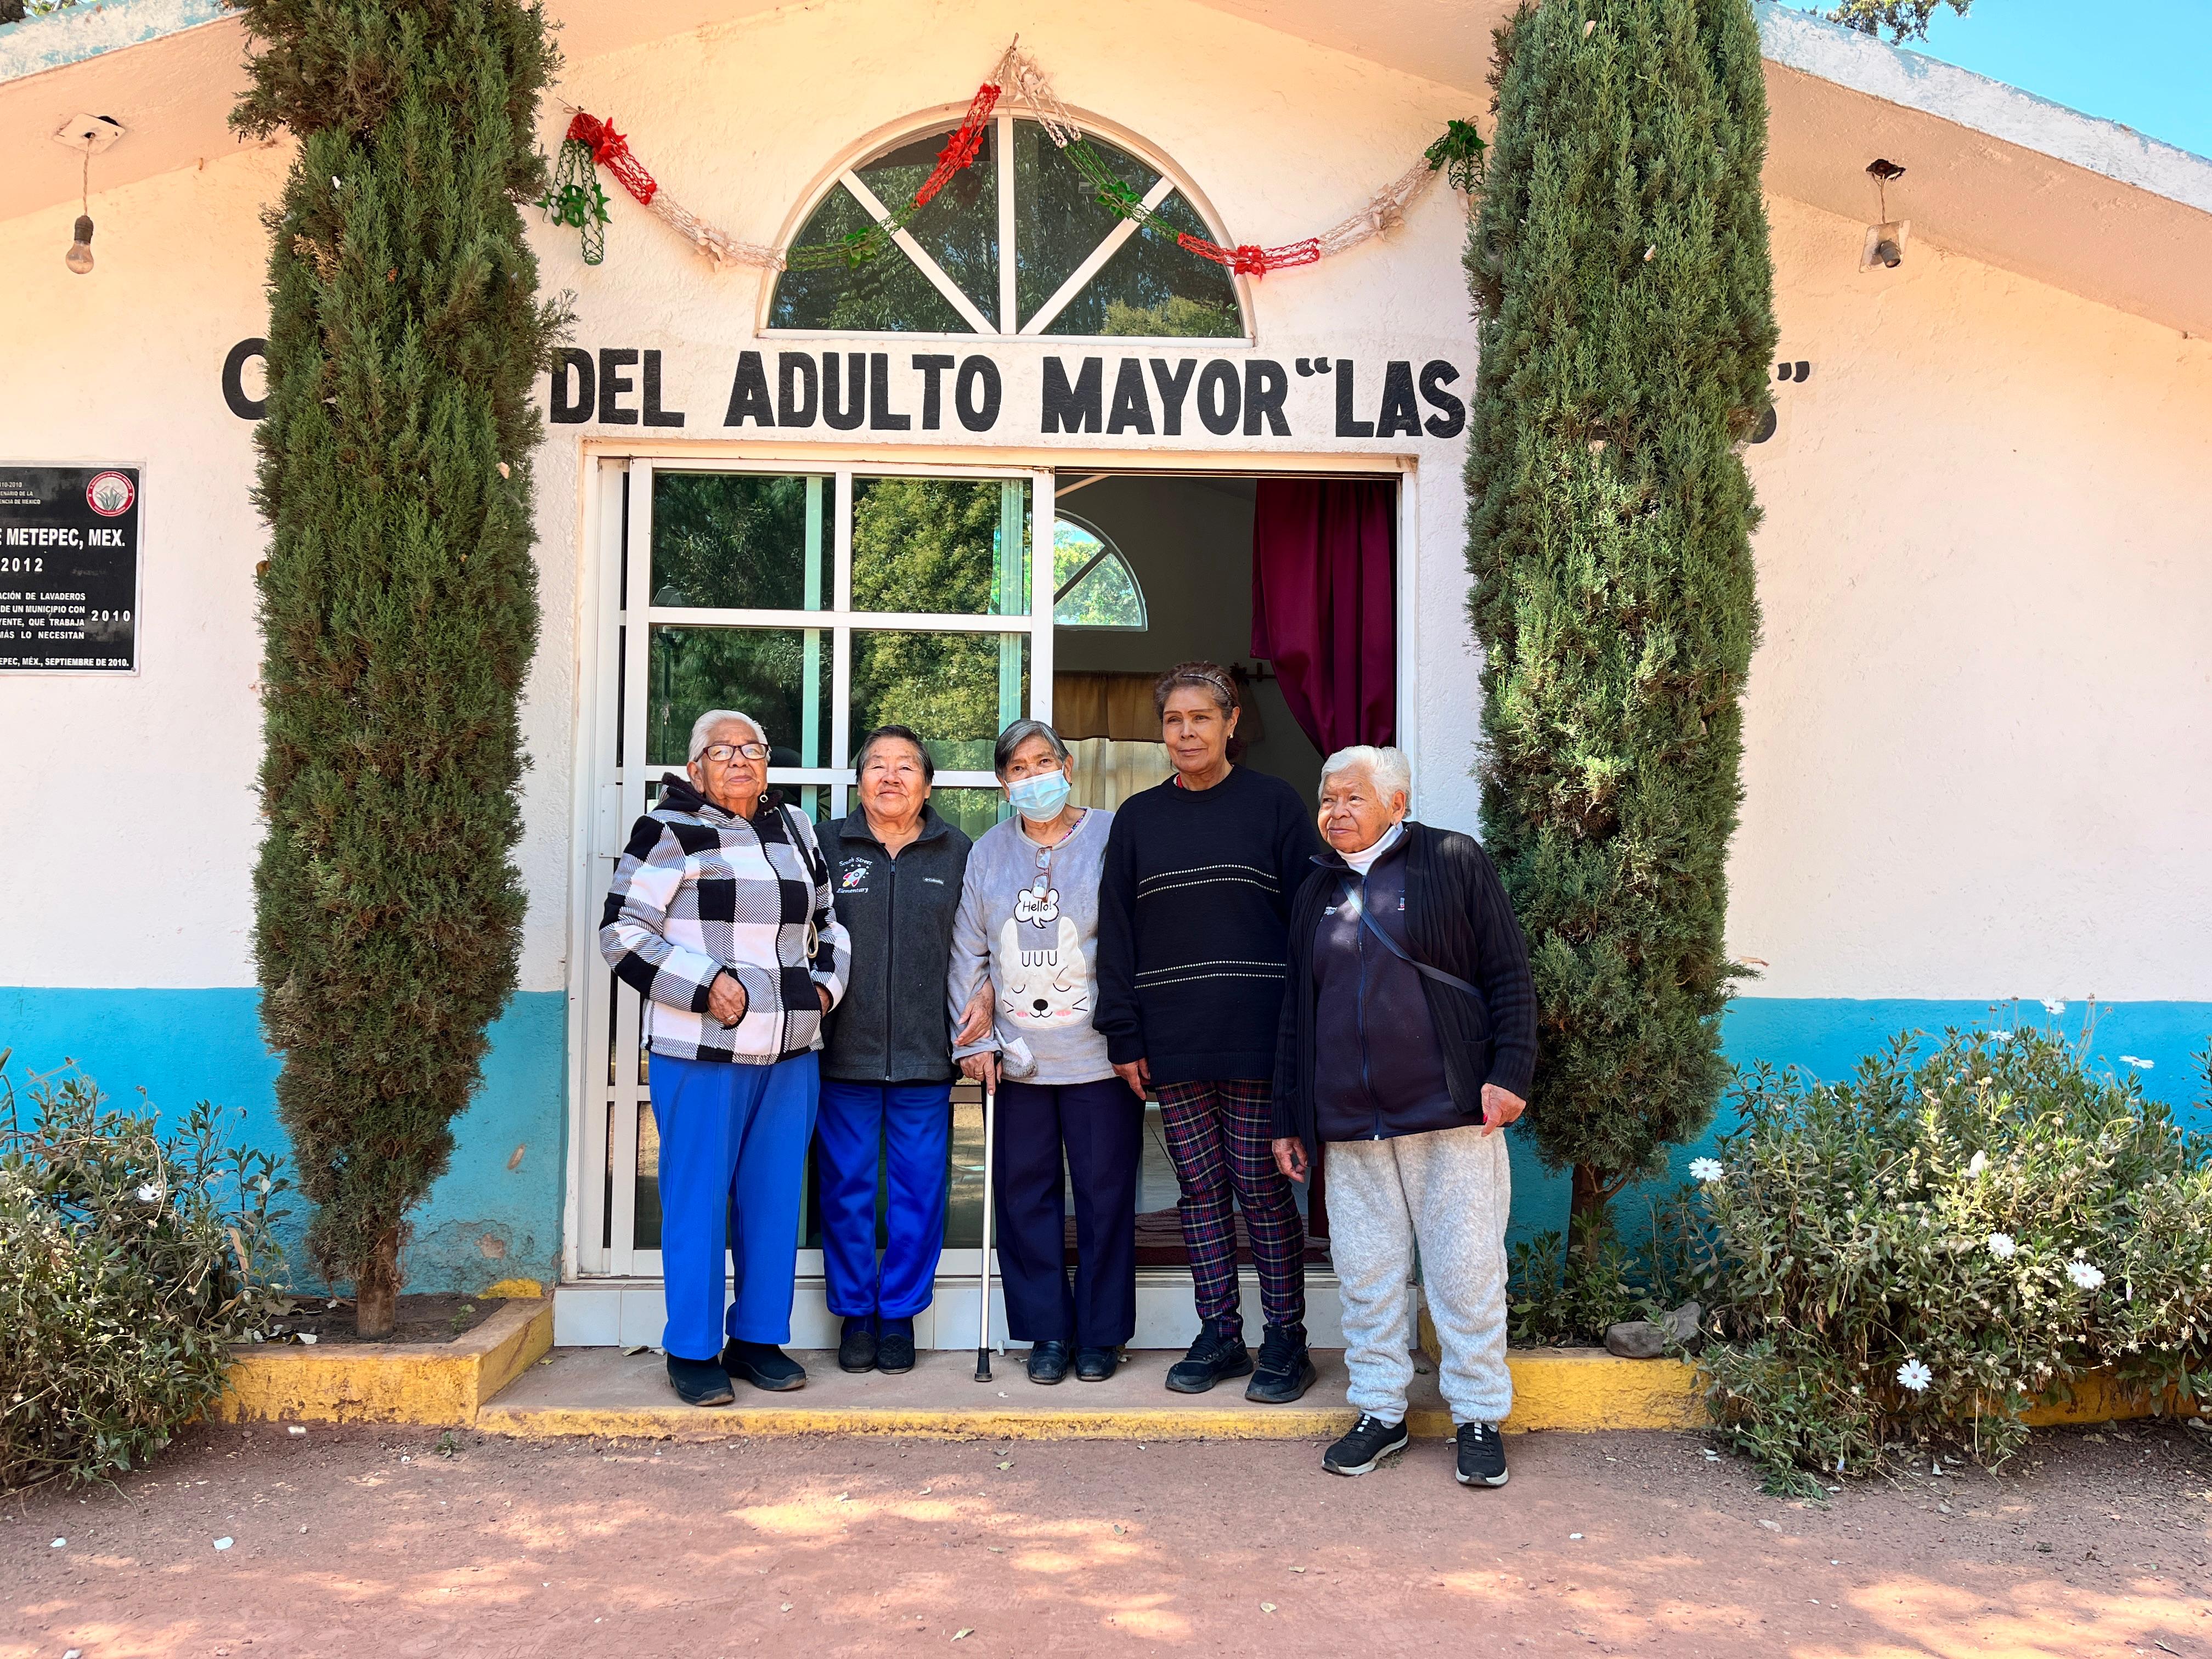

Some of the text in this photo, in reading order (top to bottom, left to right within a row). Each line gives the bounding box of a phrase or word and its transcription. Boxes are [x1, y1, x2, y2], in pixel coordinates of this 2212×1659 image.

[550, 347, 685, 428] DEL
[723, 351, 1002, 432] ADULTO
[1041, 356, 1292, 437] MAYOR
[6, 527, 83, 550] METEPEC,
[88, 528, 125, 546] MEX.
[1, 557, 43, 572] 2012
[25, 592, 36, 600] DE
[40, 592, 86, 601] LAVADEROS
[25, 605, 66, 613] MUNICIPIO
[91, 610, 131, 622] 2010
[29, 618, 45, 627] QUE
[49, 618, 84, 627] TRABAJA
[21, 631, 32, 639] LO
[38, 631, 84, 639] NECESITAN
[45, 658, 94, 666] SEPTIEMBRE
[108, 658, 129, 667] 2010.
[1023, 900, 1052, 912] Hello!
